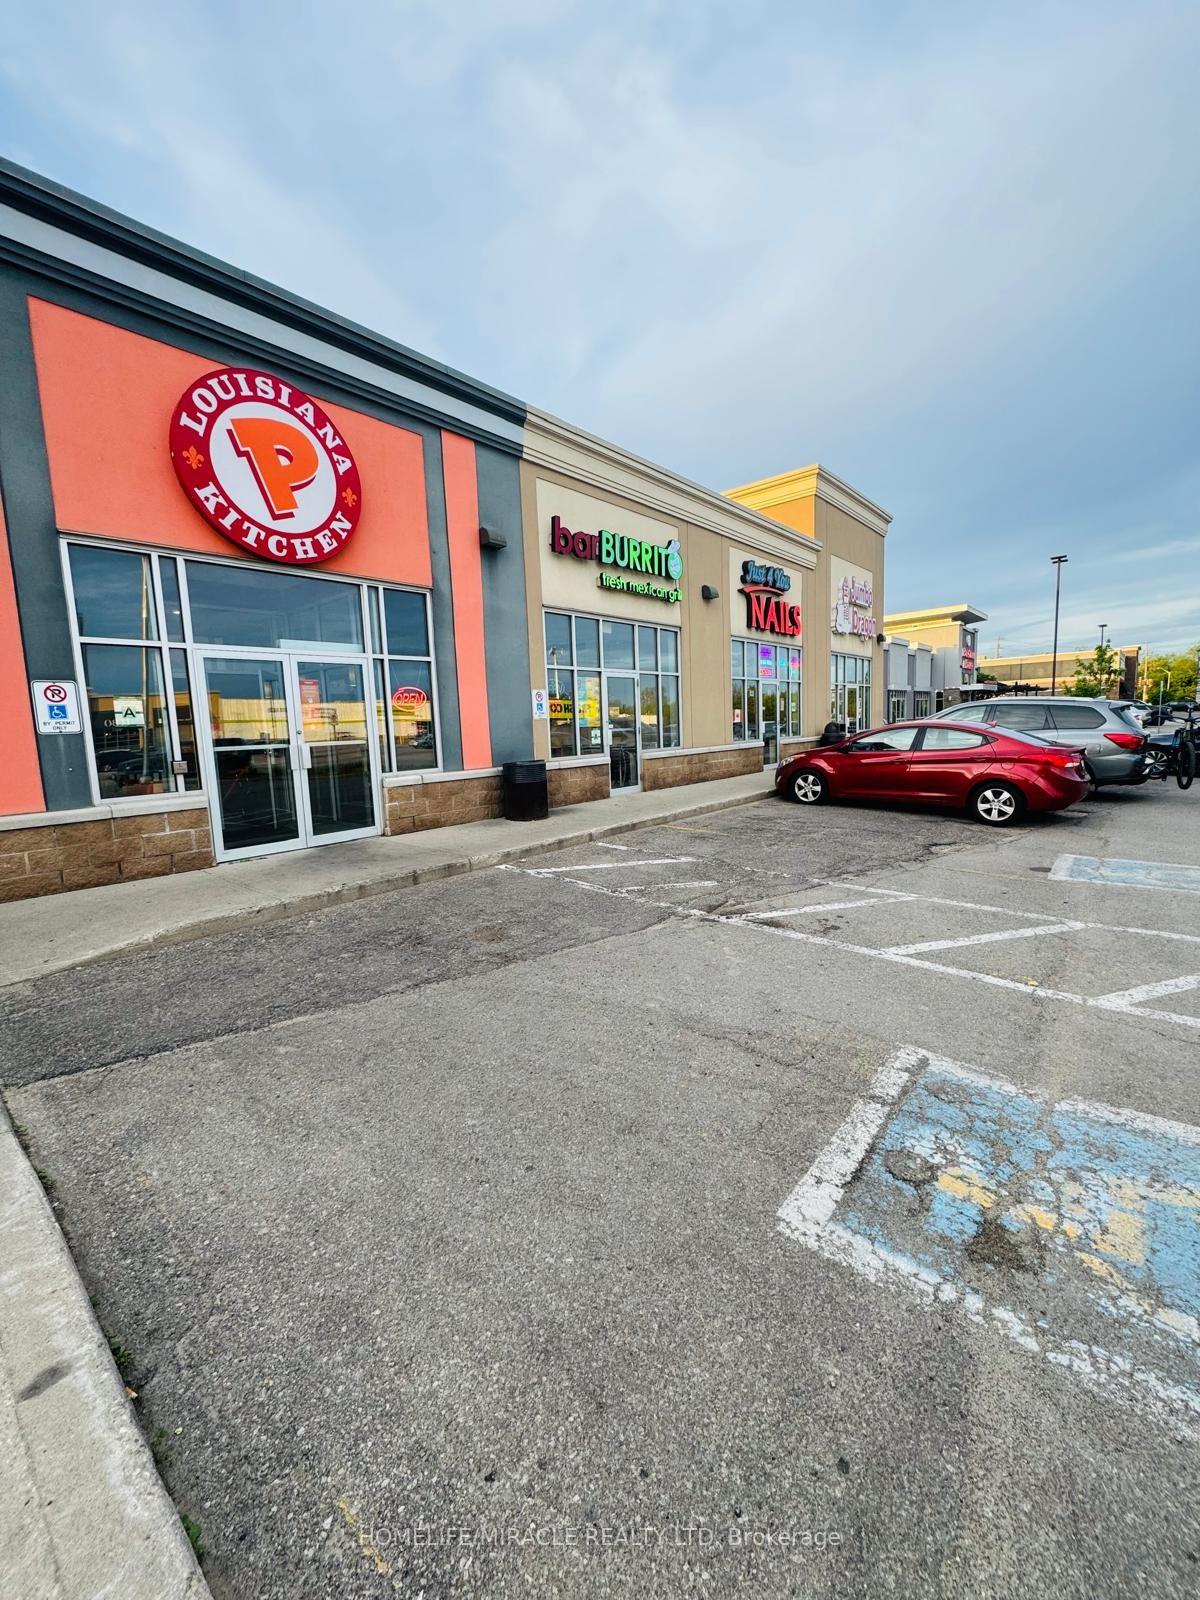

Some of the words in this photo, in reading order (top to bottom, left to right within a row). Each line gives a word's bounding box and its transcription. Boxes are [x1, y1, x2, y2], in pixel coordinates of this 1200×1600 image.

[179, 373, 352, 475] LOUISIANA
[226, 417, 319, 521] P
[194, 481, 352, 559] KITCHEN
[600, 572, 627, 591] fresh
[629, 581, 667, 599] mexican
[742, 561, 766, 583] Just
[766, 565, 774, 586] 4
[774, 568, 790, 591] You
[850, 576, 873, 608] Jumbo
[747, 591, 801, 636] NAILS
[852, 606, 877, 641] Dragon
[123, 707, 136, 718] A
[396, 694, 424, 705] OPEN
